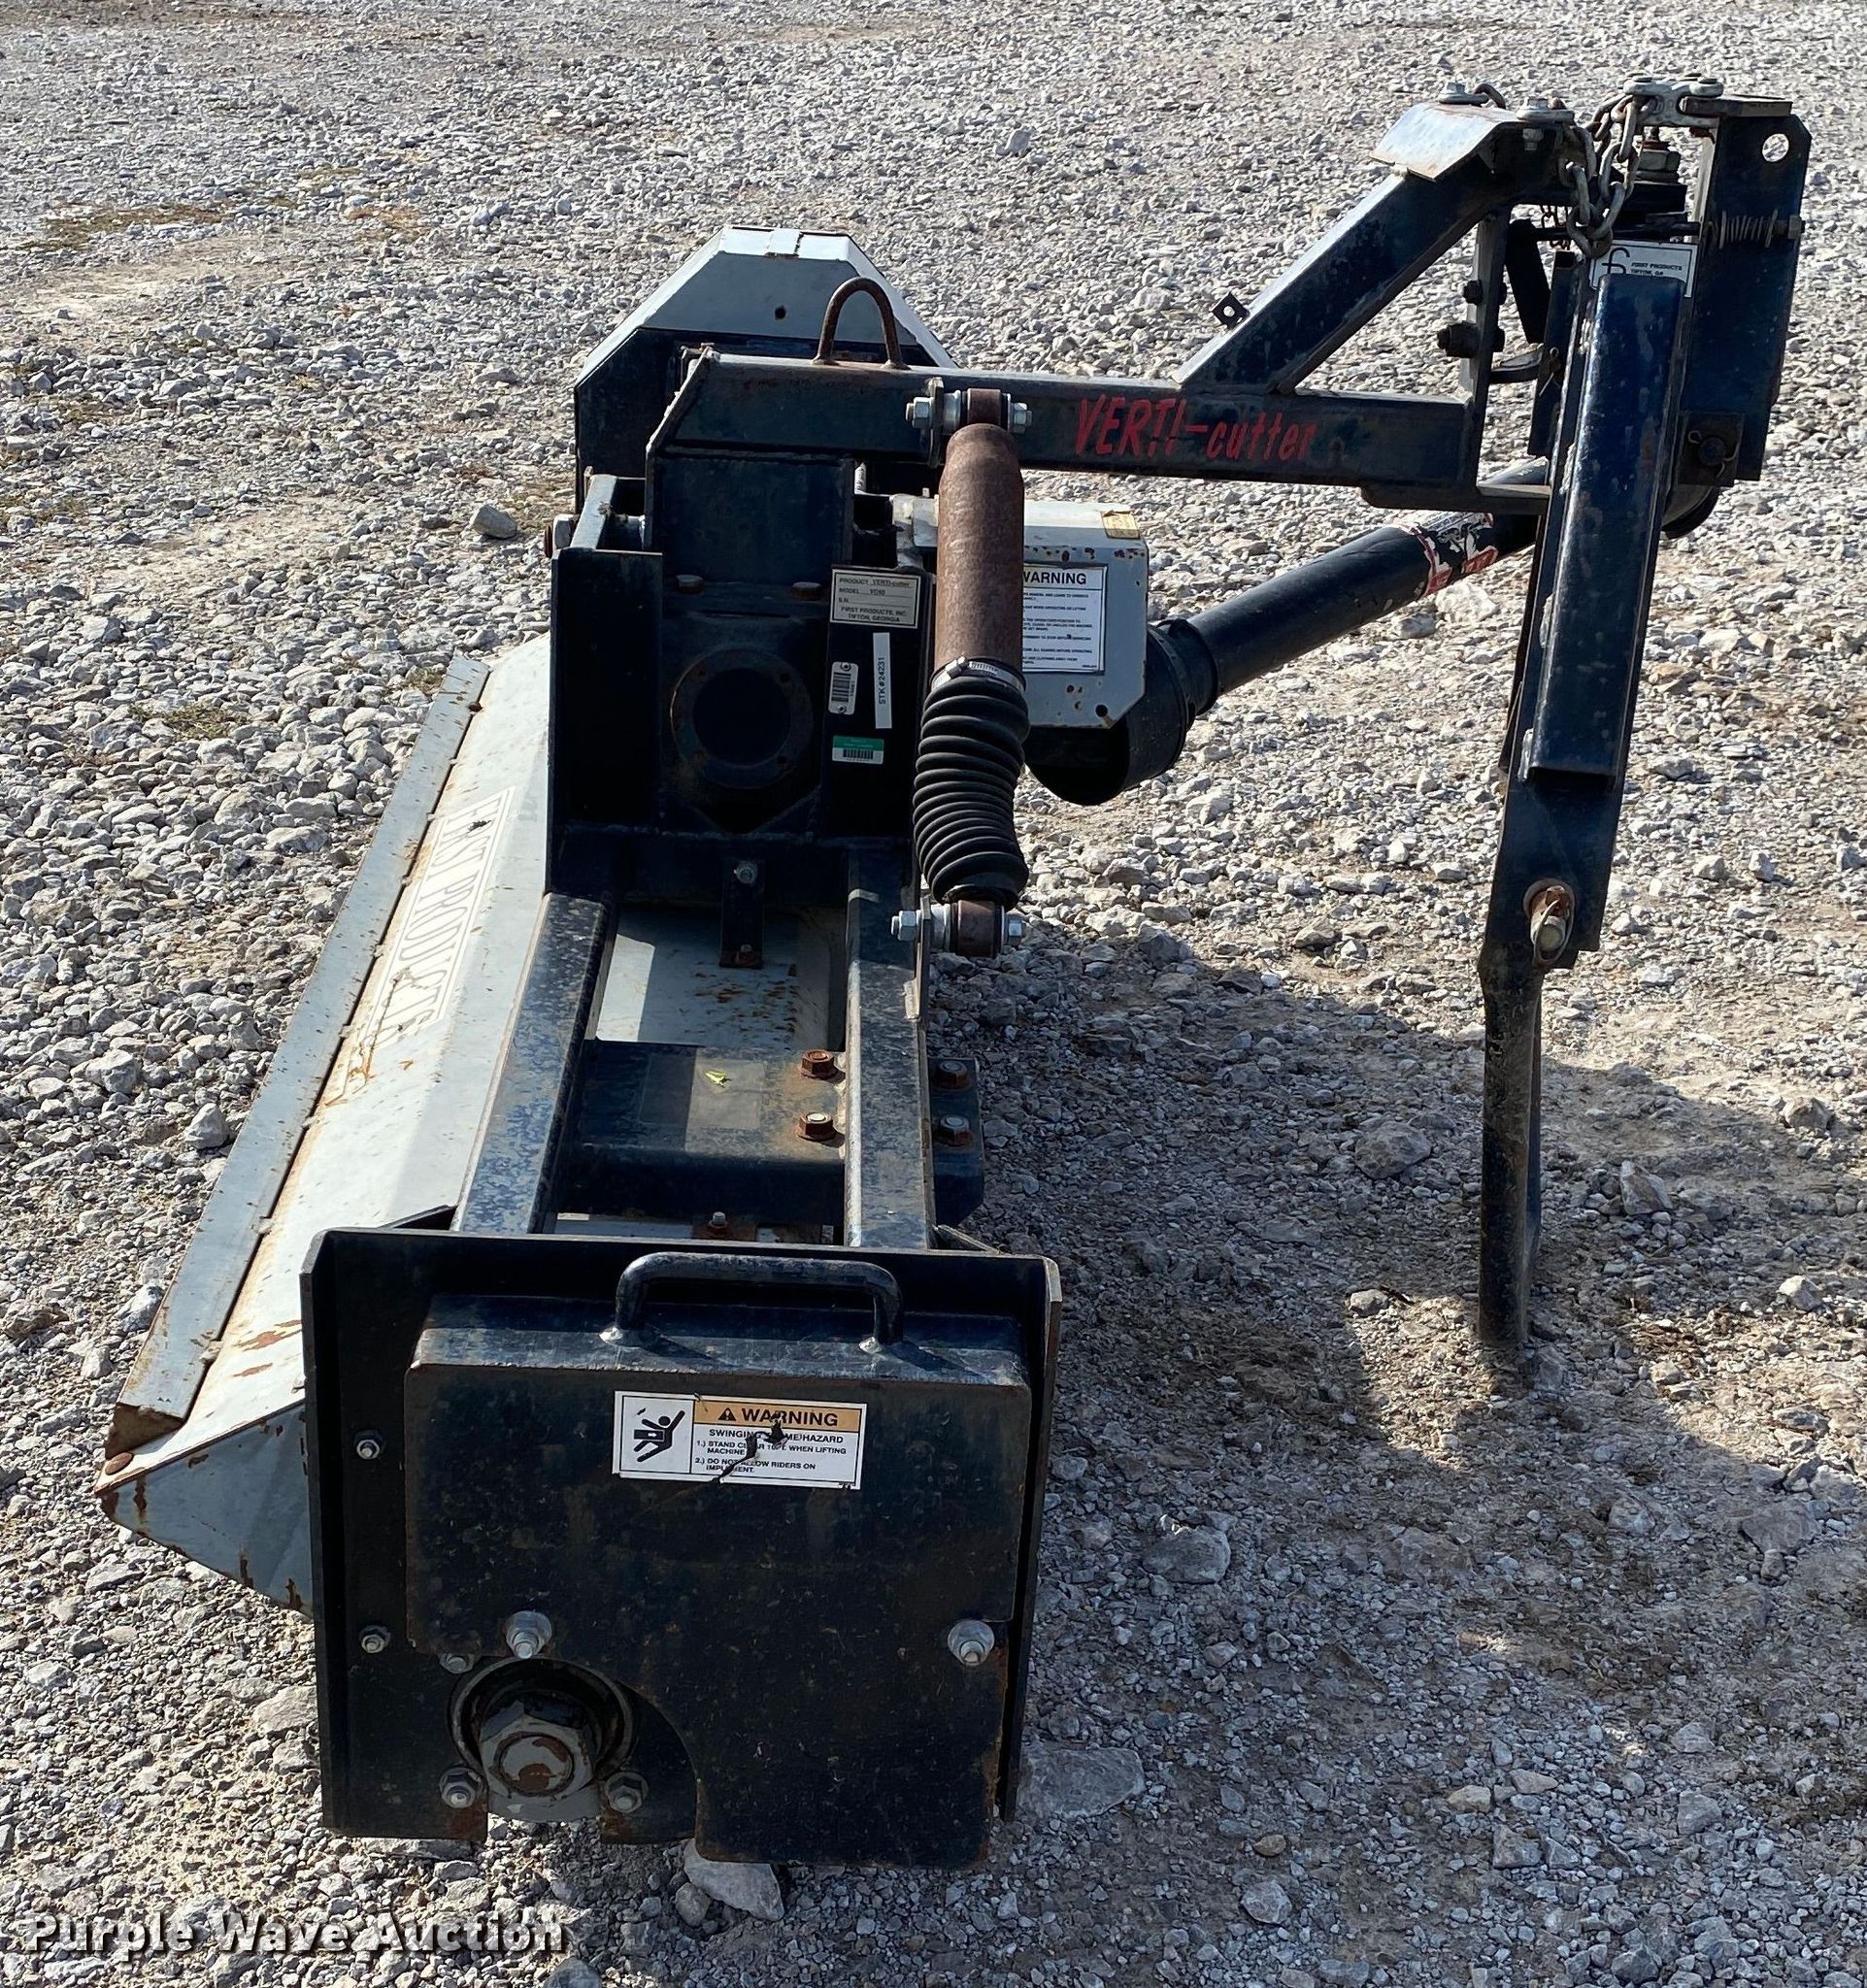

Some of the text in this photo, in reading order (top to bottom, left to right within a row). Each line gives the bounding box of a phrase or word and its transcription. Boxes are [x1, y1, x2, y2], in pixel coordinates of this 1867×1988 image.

[741, 1408, 839, 1427] WARNING
[707, 1447, 746, 1456] MACHINE
[815, 1446, 847, 1455] LIFTING
[771, 1461, 802, 1470] RIDERS
